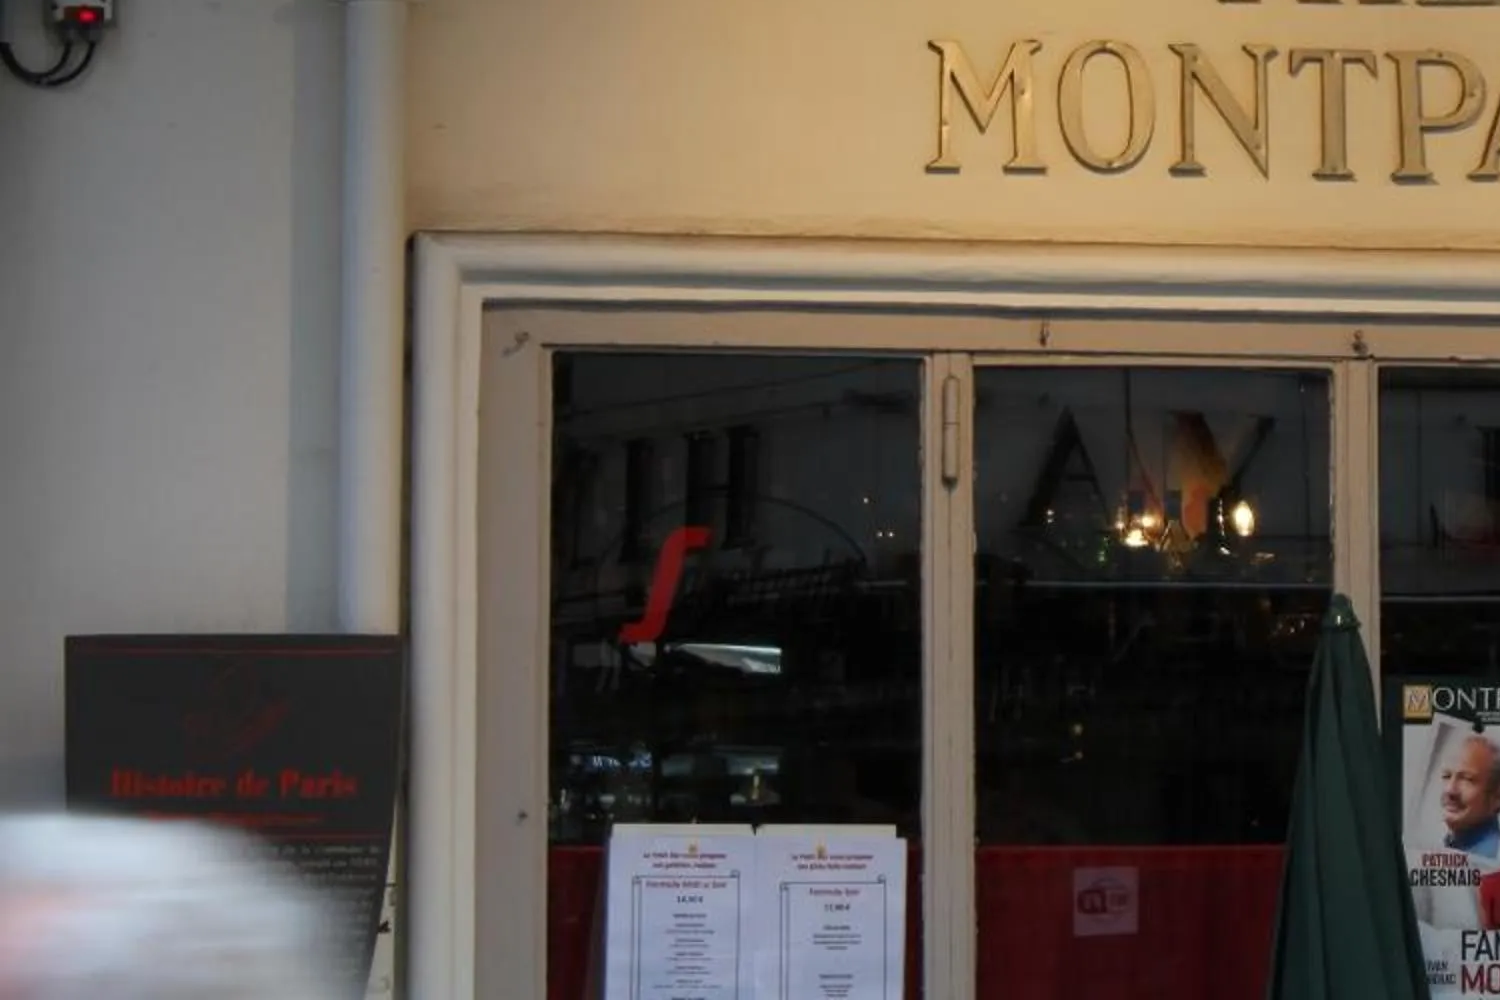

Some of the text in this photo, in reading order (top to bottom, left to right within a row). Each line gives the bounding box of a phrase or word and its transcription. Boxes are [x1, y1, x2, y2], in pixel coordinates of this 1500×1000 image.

[110, 766, 358, 799] Histoire de Paris
[1422, 853, 1469, 867] PATRICK
[1410, 869, 1481, 887] CHESNAIS
